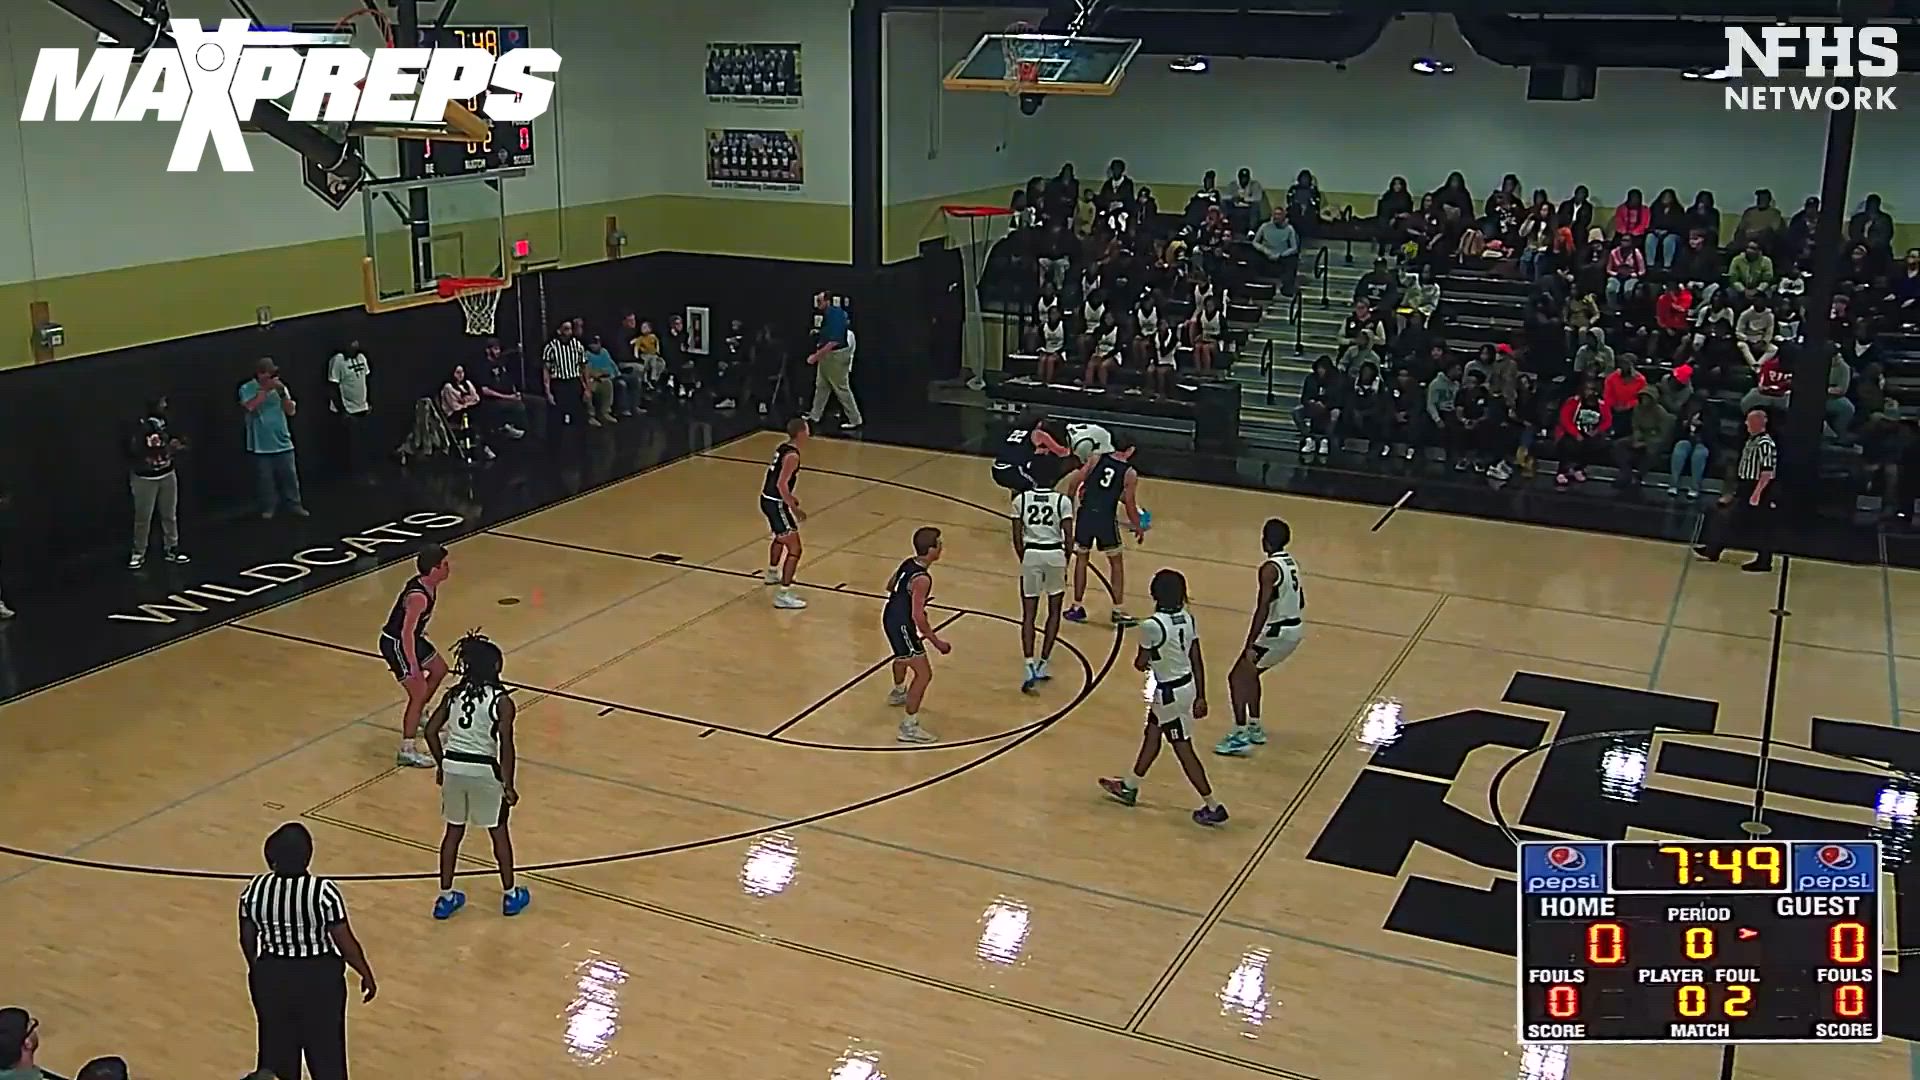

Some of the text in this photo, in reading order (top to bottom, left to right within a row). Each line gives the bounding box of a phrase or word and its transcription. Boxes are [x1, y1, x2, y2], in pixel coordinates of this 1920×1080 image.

[1099, 467, 1115, 488] 3
[1027, 504, 1054, 527] 22
[108, 511, 464, 624] WILDCATS
